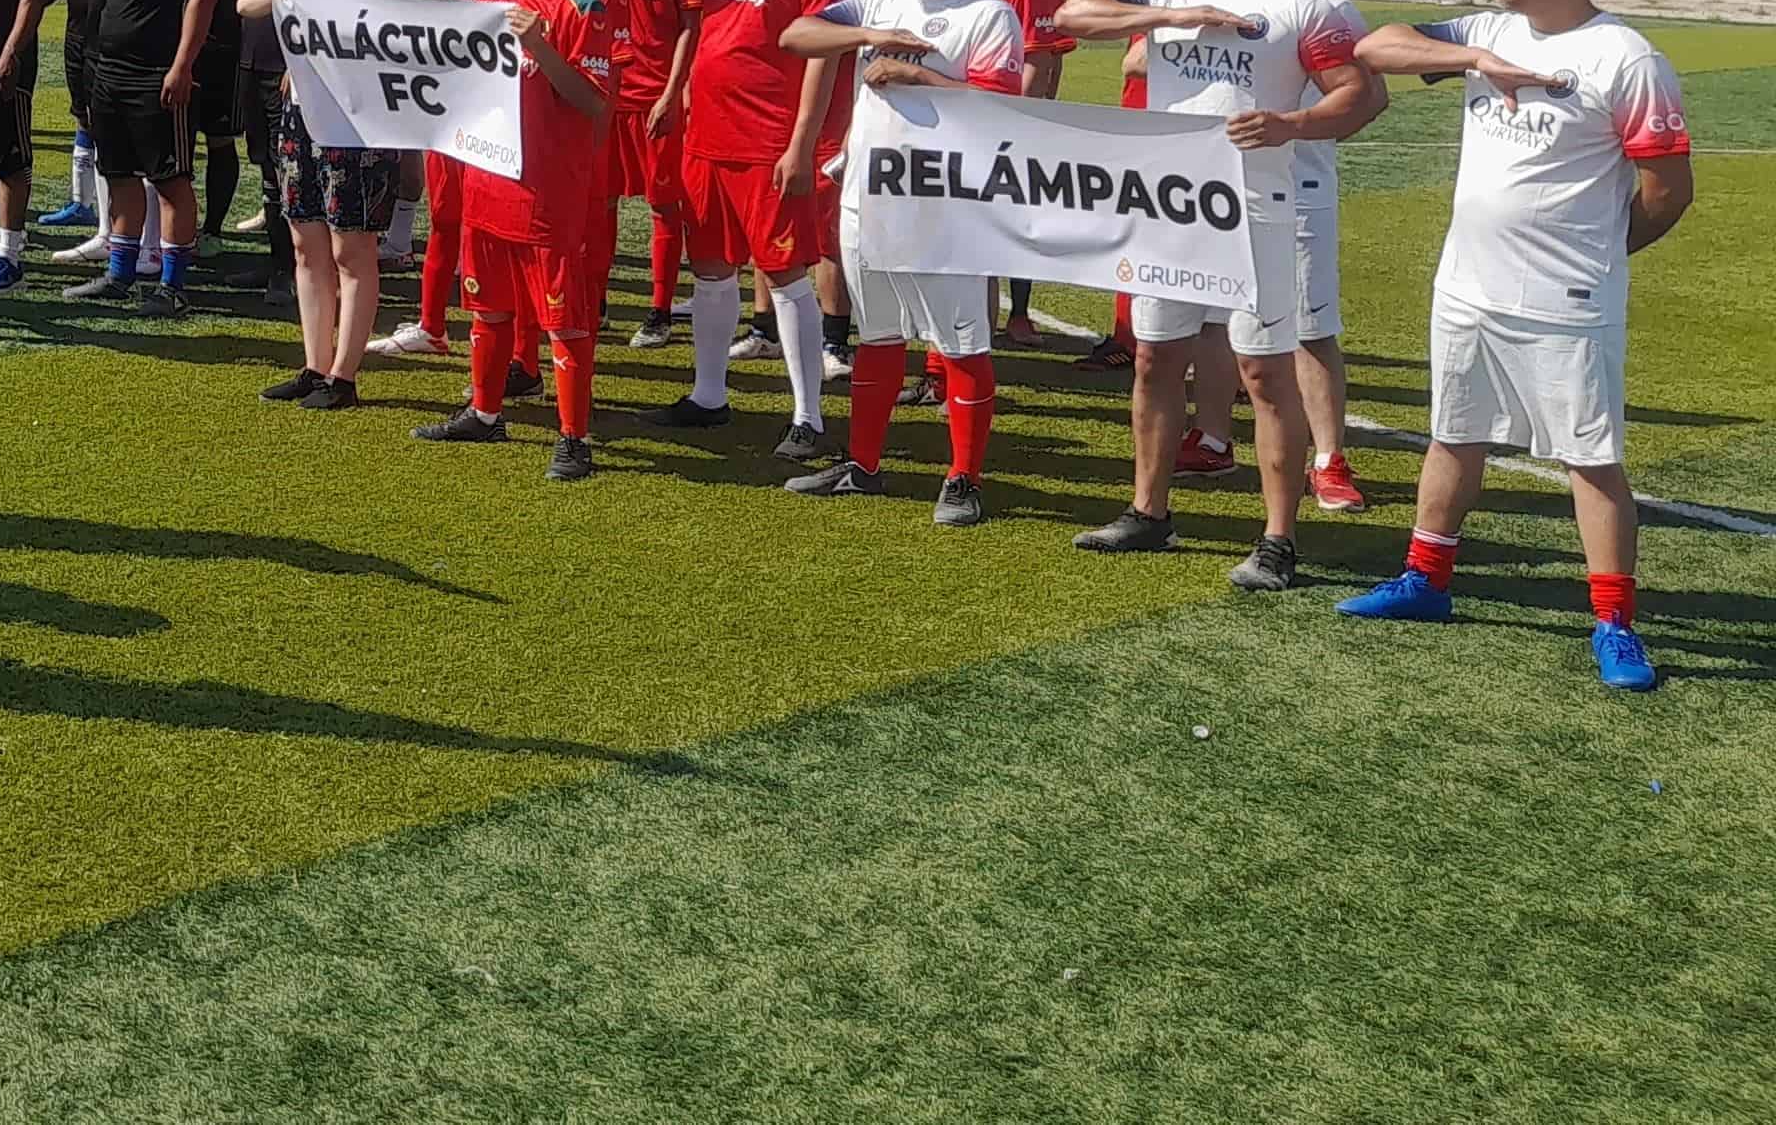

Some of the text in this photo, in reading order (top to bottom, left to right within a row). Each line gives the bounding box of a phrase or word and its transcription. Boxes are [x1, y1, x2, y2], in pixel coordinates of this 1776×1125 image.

[281, 9, 520, 77] GALÁCTICOS
[1161, 41, 1254, 73] QATAR
[379, 73, 446, 116] FC
[1179, 66, 1253, 88] AIRWAYS
[868, 142, 1242, 231] RELÁMPAGO
[1138, 264, 1247, 298] GRUPOFOX
